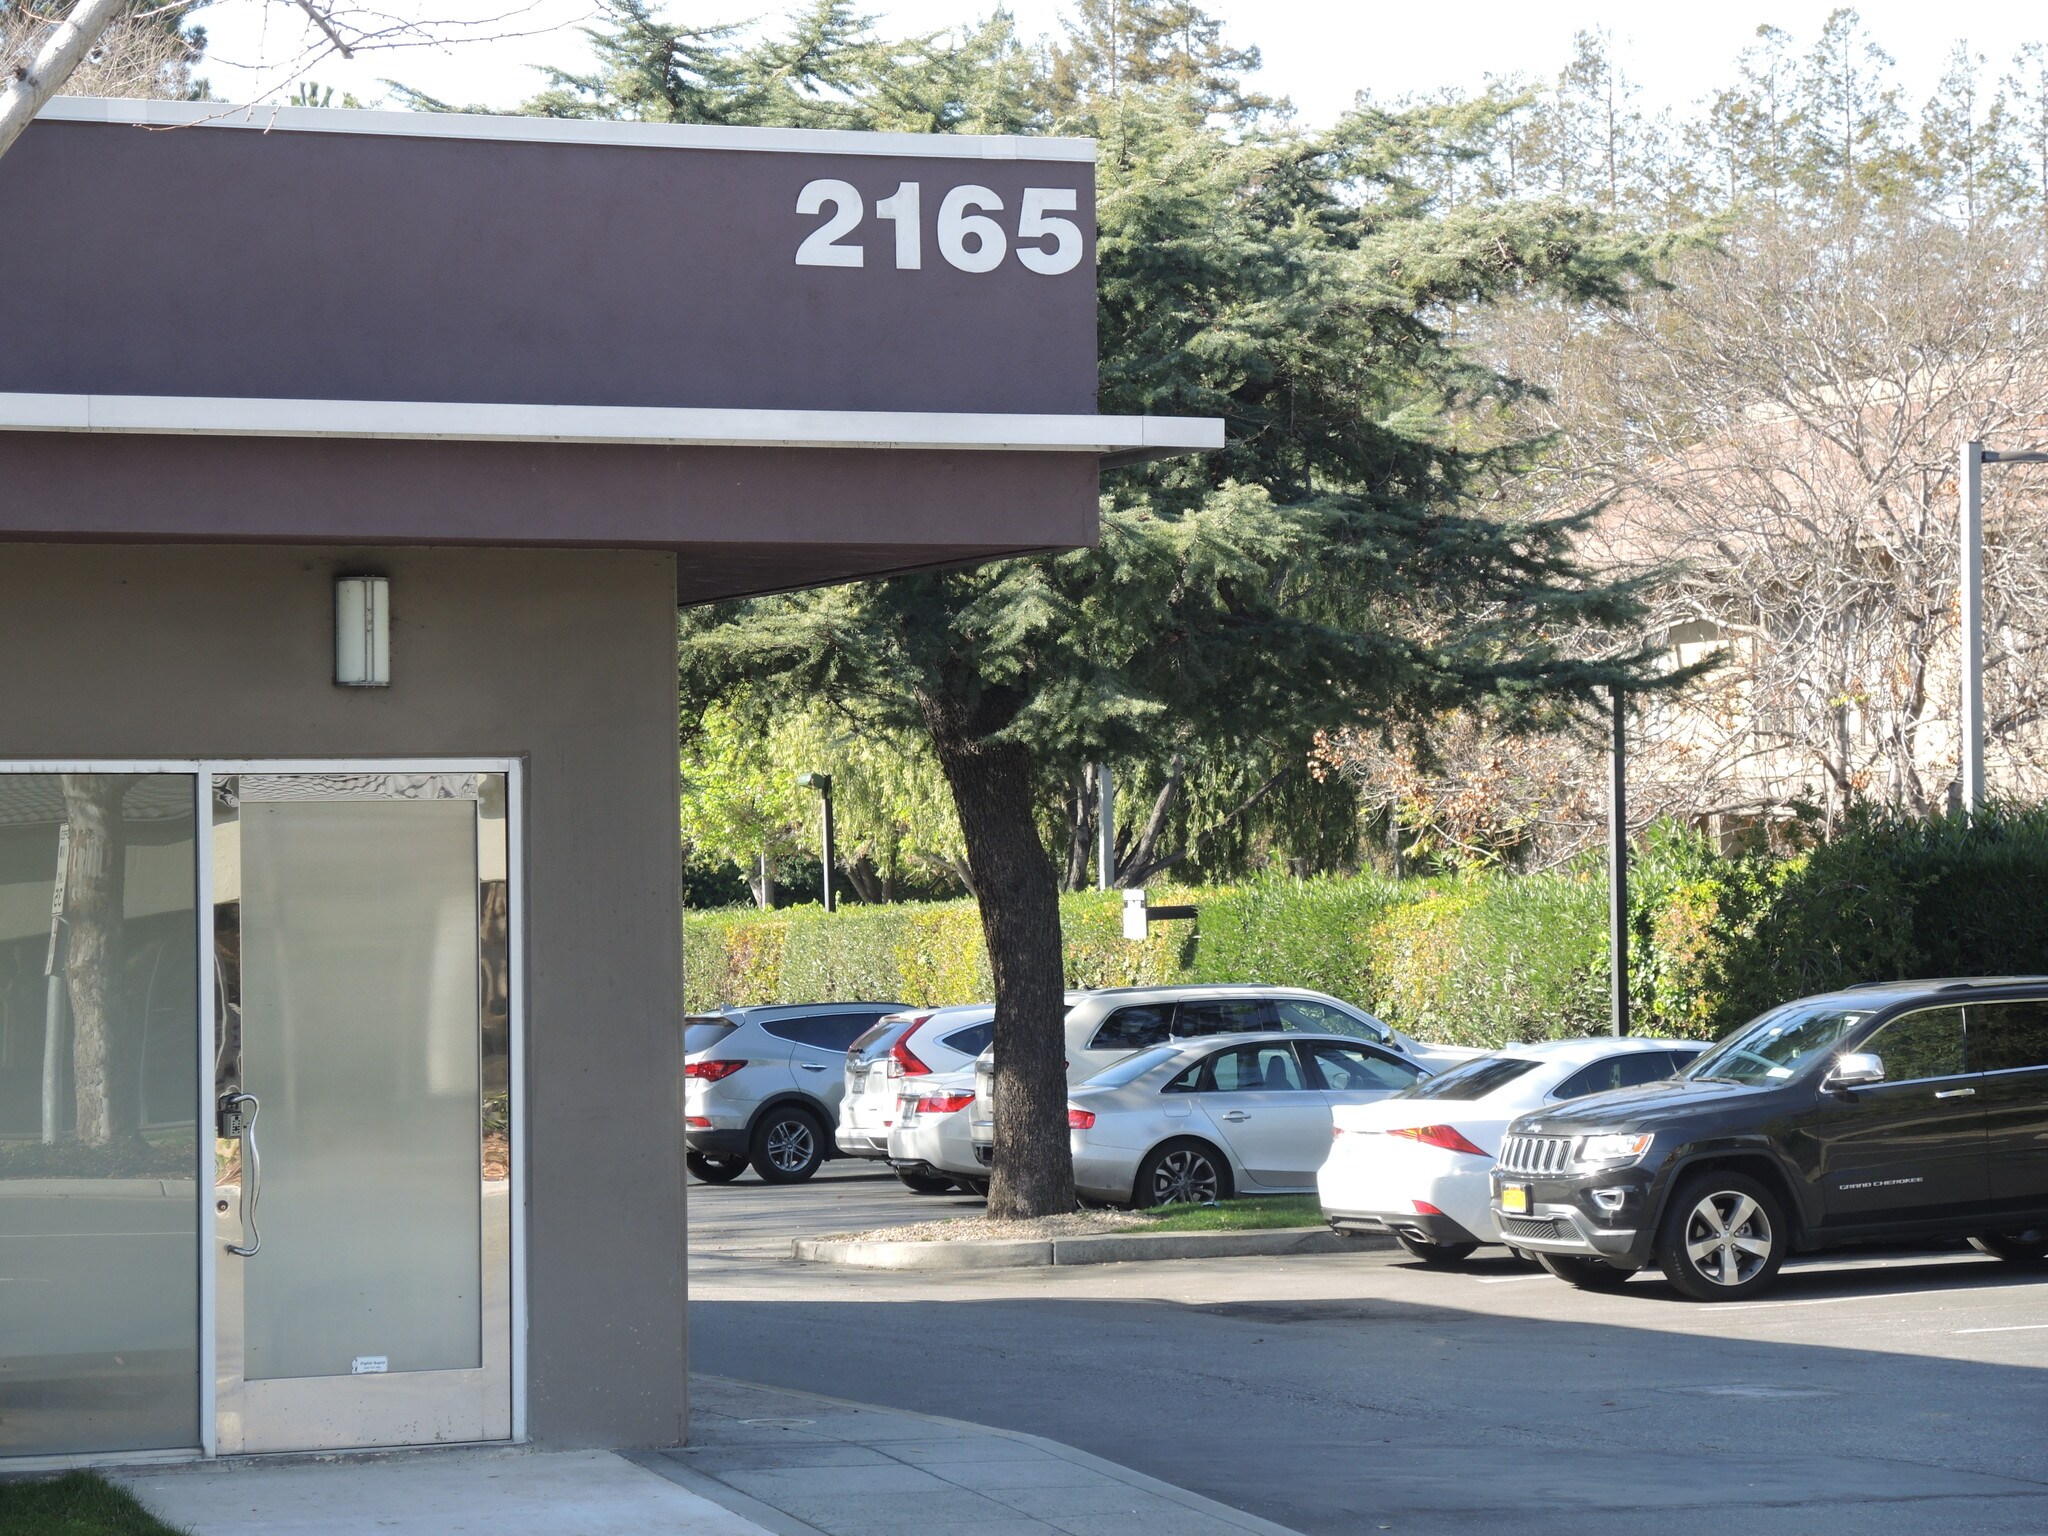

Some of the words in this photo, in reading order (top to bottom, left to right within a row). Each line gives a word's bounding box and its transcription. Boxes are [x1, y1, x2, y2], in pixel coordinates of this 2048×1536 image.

[795, 178, 1084, 276] 2165
[1839, 1182, 1872, 1190] GRAND
[1873, 1177, 1924, 1187] CHEROKEE
